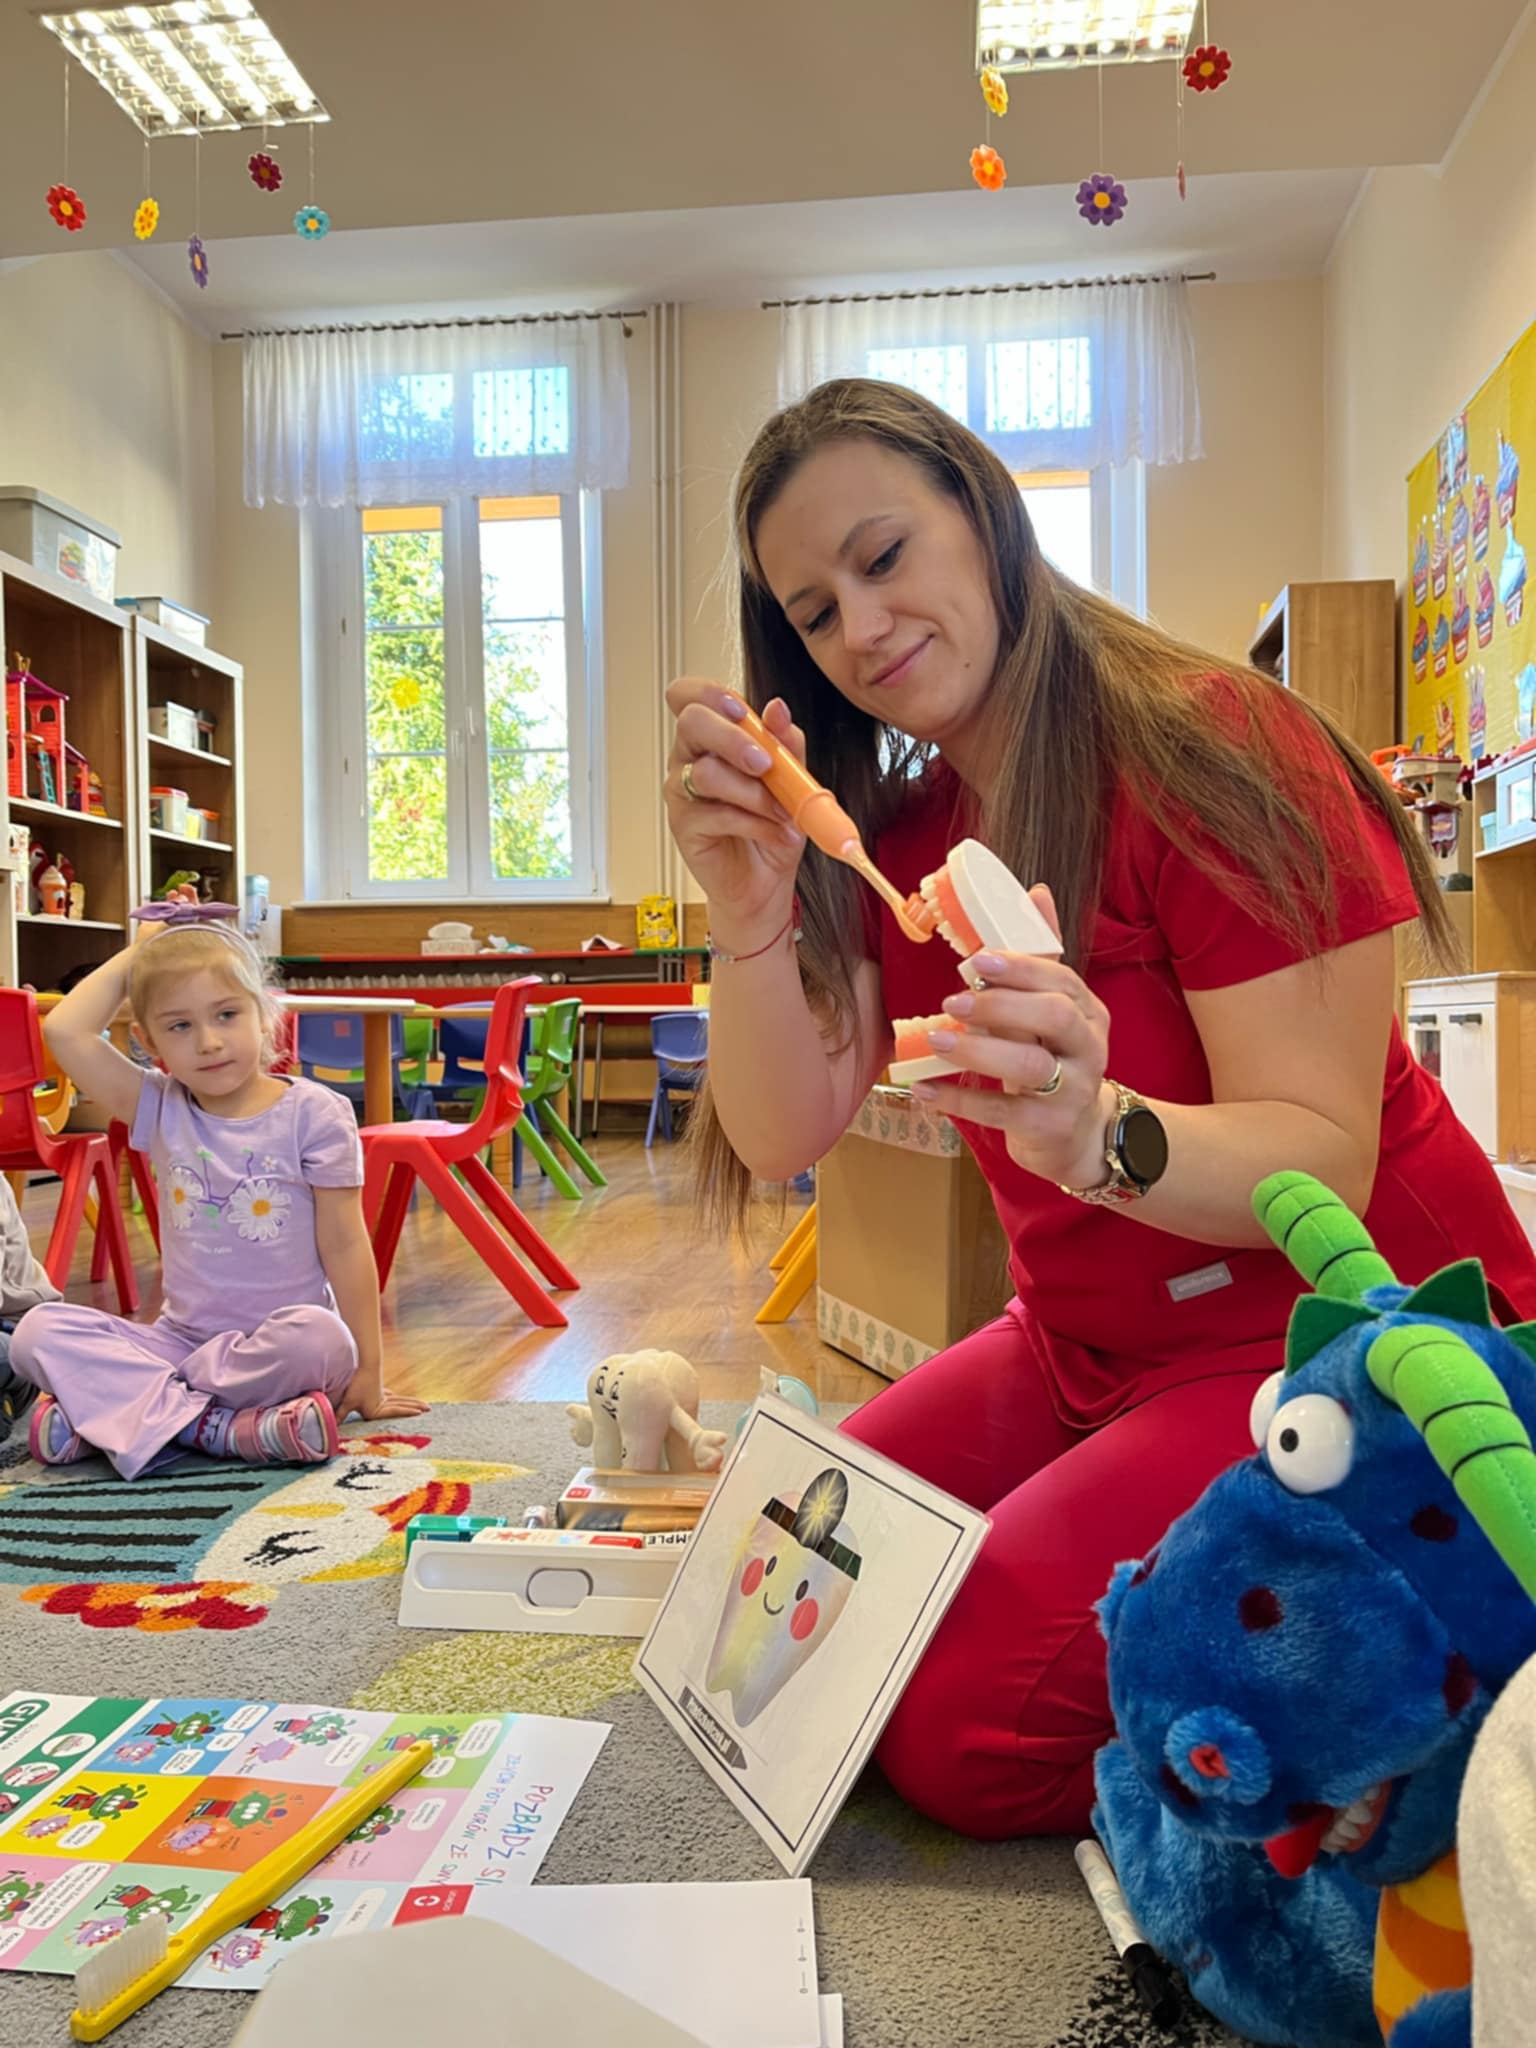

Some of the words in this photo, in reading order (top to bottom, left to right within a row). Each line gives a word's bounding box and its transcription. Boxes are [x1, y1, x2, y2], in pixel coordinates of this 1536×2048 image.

[646, 1533, 689, 1546] MPLE
[462, 1787, 506, 1839] POTWORÓW
[450, 1843, 468, 1859] ZE
